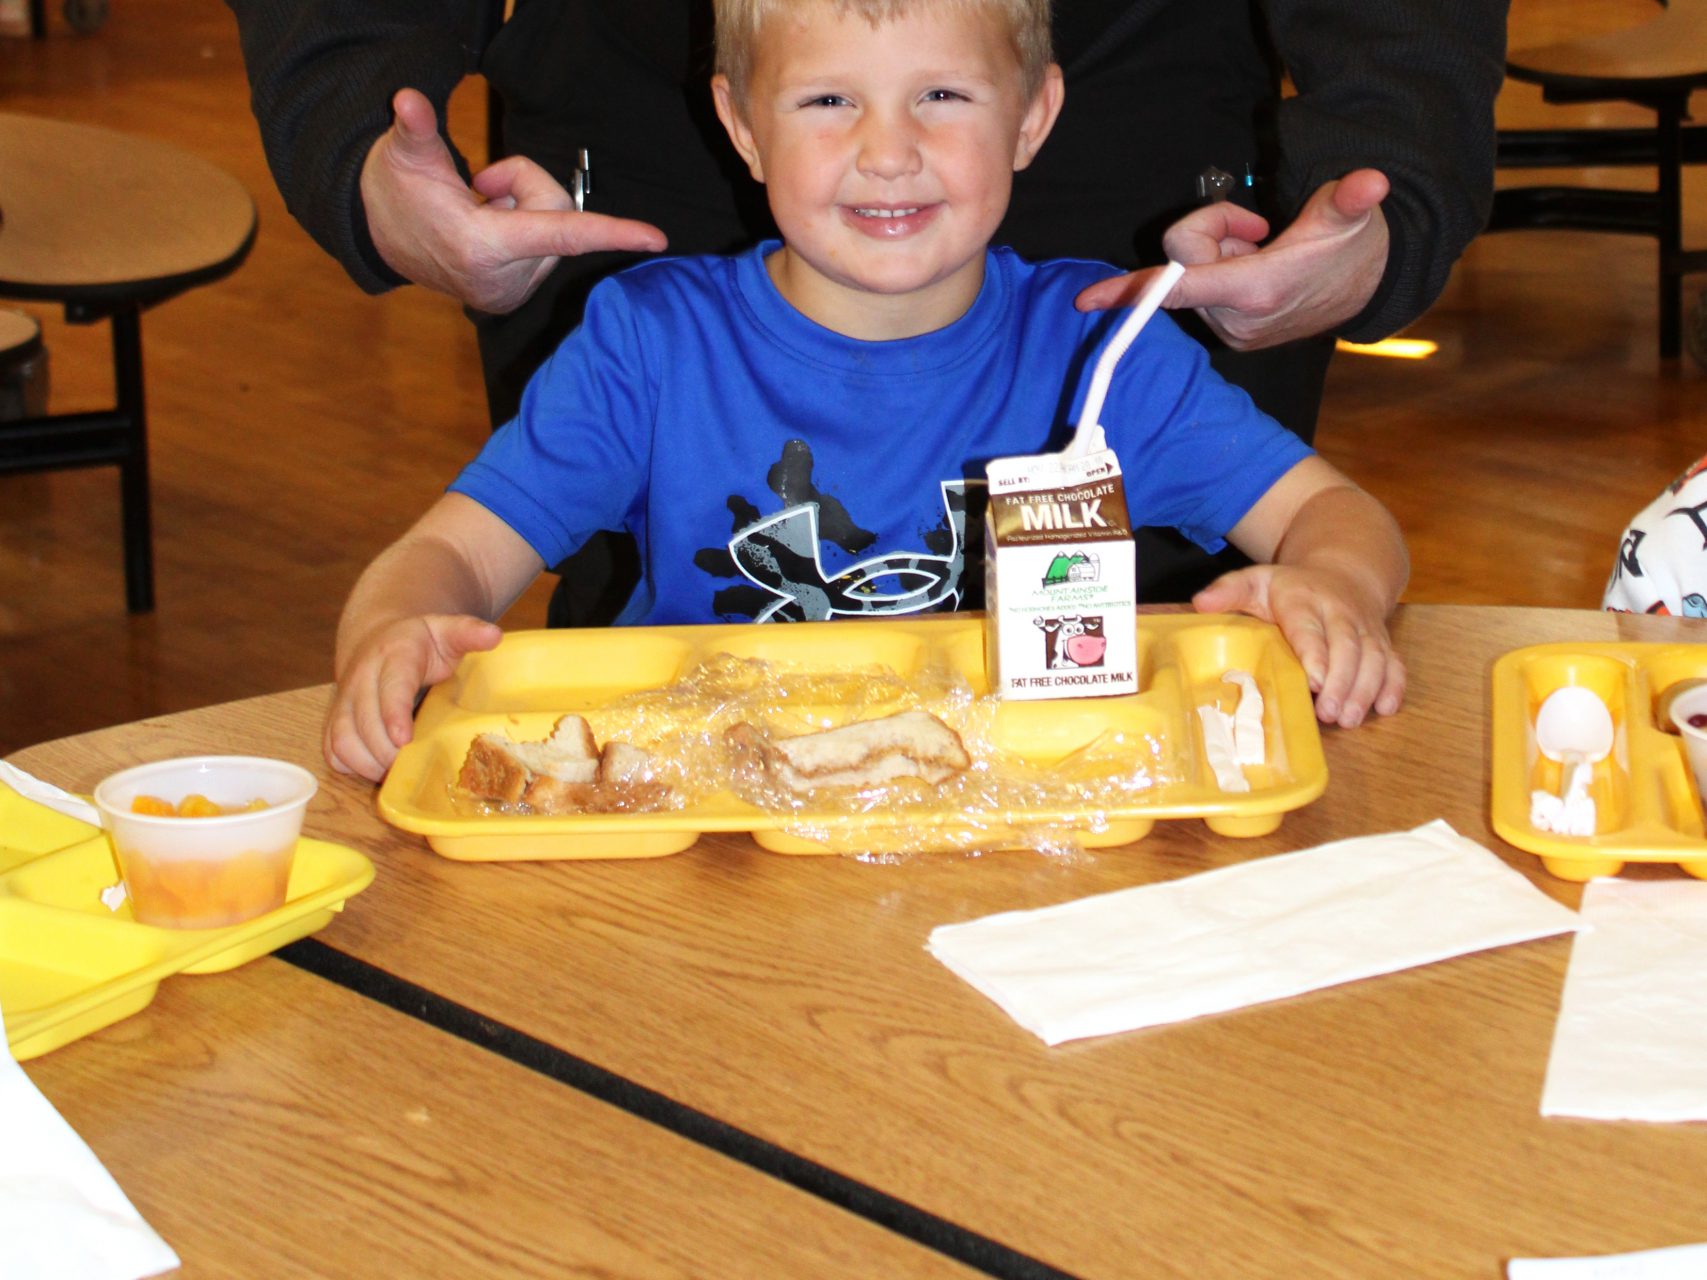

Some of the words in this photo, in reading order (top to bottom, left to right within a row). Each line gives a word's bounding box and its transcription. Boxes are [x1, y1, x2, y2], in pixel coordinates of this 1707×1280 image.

[1086, 466, 1106, 478] OPEN
[998, 478, 1016, 487] SELL
[1006, 496, 1025, 506] FAT
[1029, 493, 1054, 504] FREE
[1057, 483, 1115, 503] CHOCOLATE
[1020, 499, 1107, 532] MILK
[1011, 677, 1027, 688] FAT
[1030, 676, 1052, 687] FREE
[1055, 673, 1108, 686] CHOCOLATE
[1111, 671, 1133, 683] MILK
